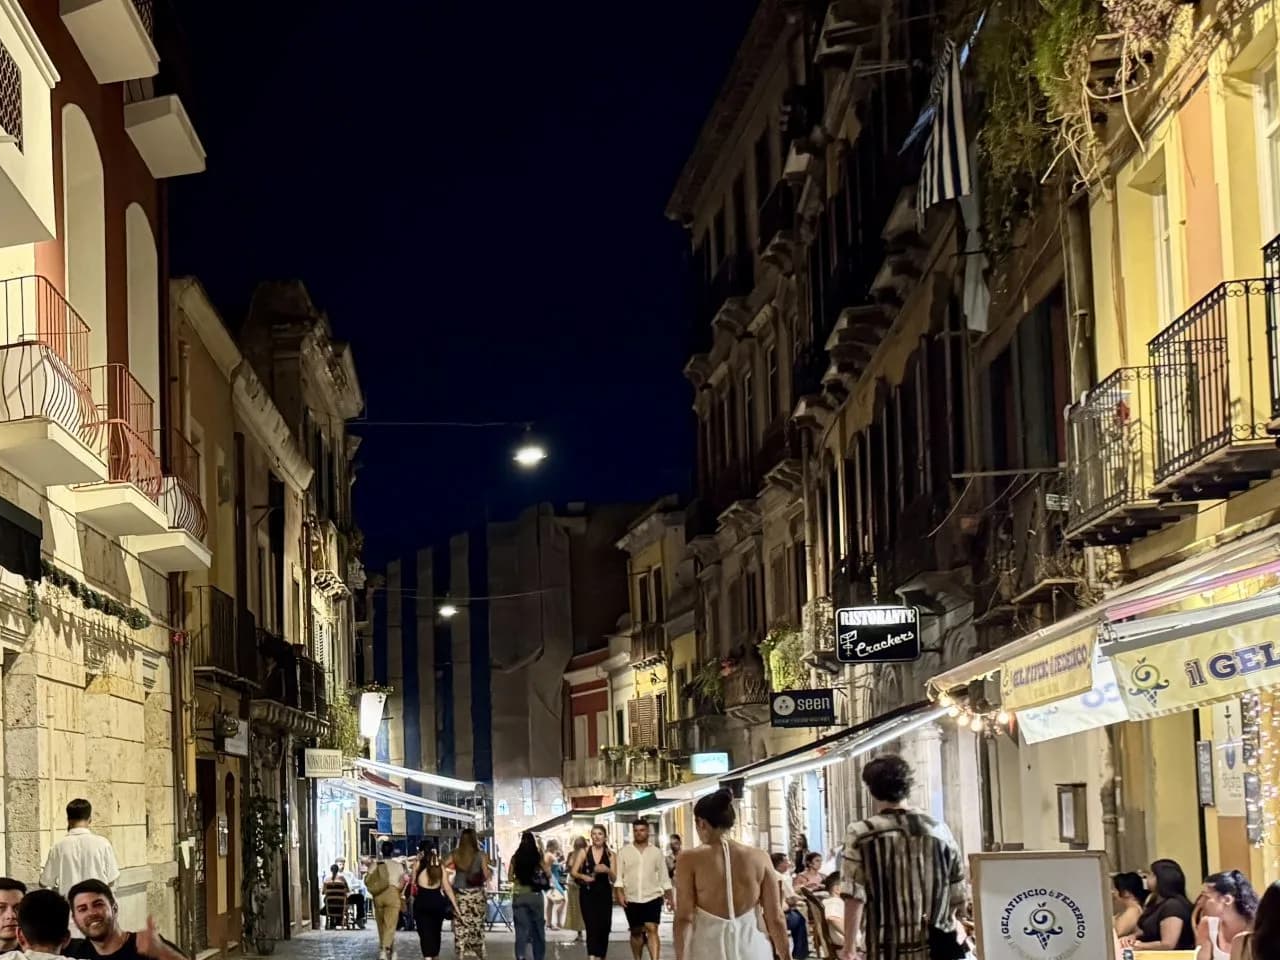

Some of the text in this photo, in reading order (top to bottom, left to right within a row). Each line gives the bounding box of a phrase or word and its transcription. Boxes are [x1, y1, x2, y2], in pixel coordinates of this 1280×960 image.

[840, 609, 916, 626] RISTORANTE
[855, 631, 914, 657] Crackers
[1185, 660, 1207, 687] il
[797, 697, 831, 711] seen
[1001, 888, 1048, 935] GELATIFICIO
[1055, 892, 1086, 939] FEDERICO
